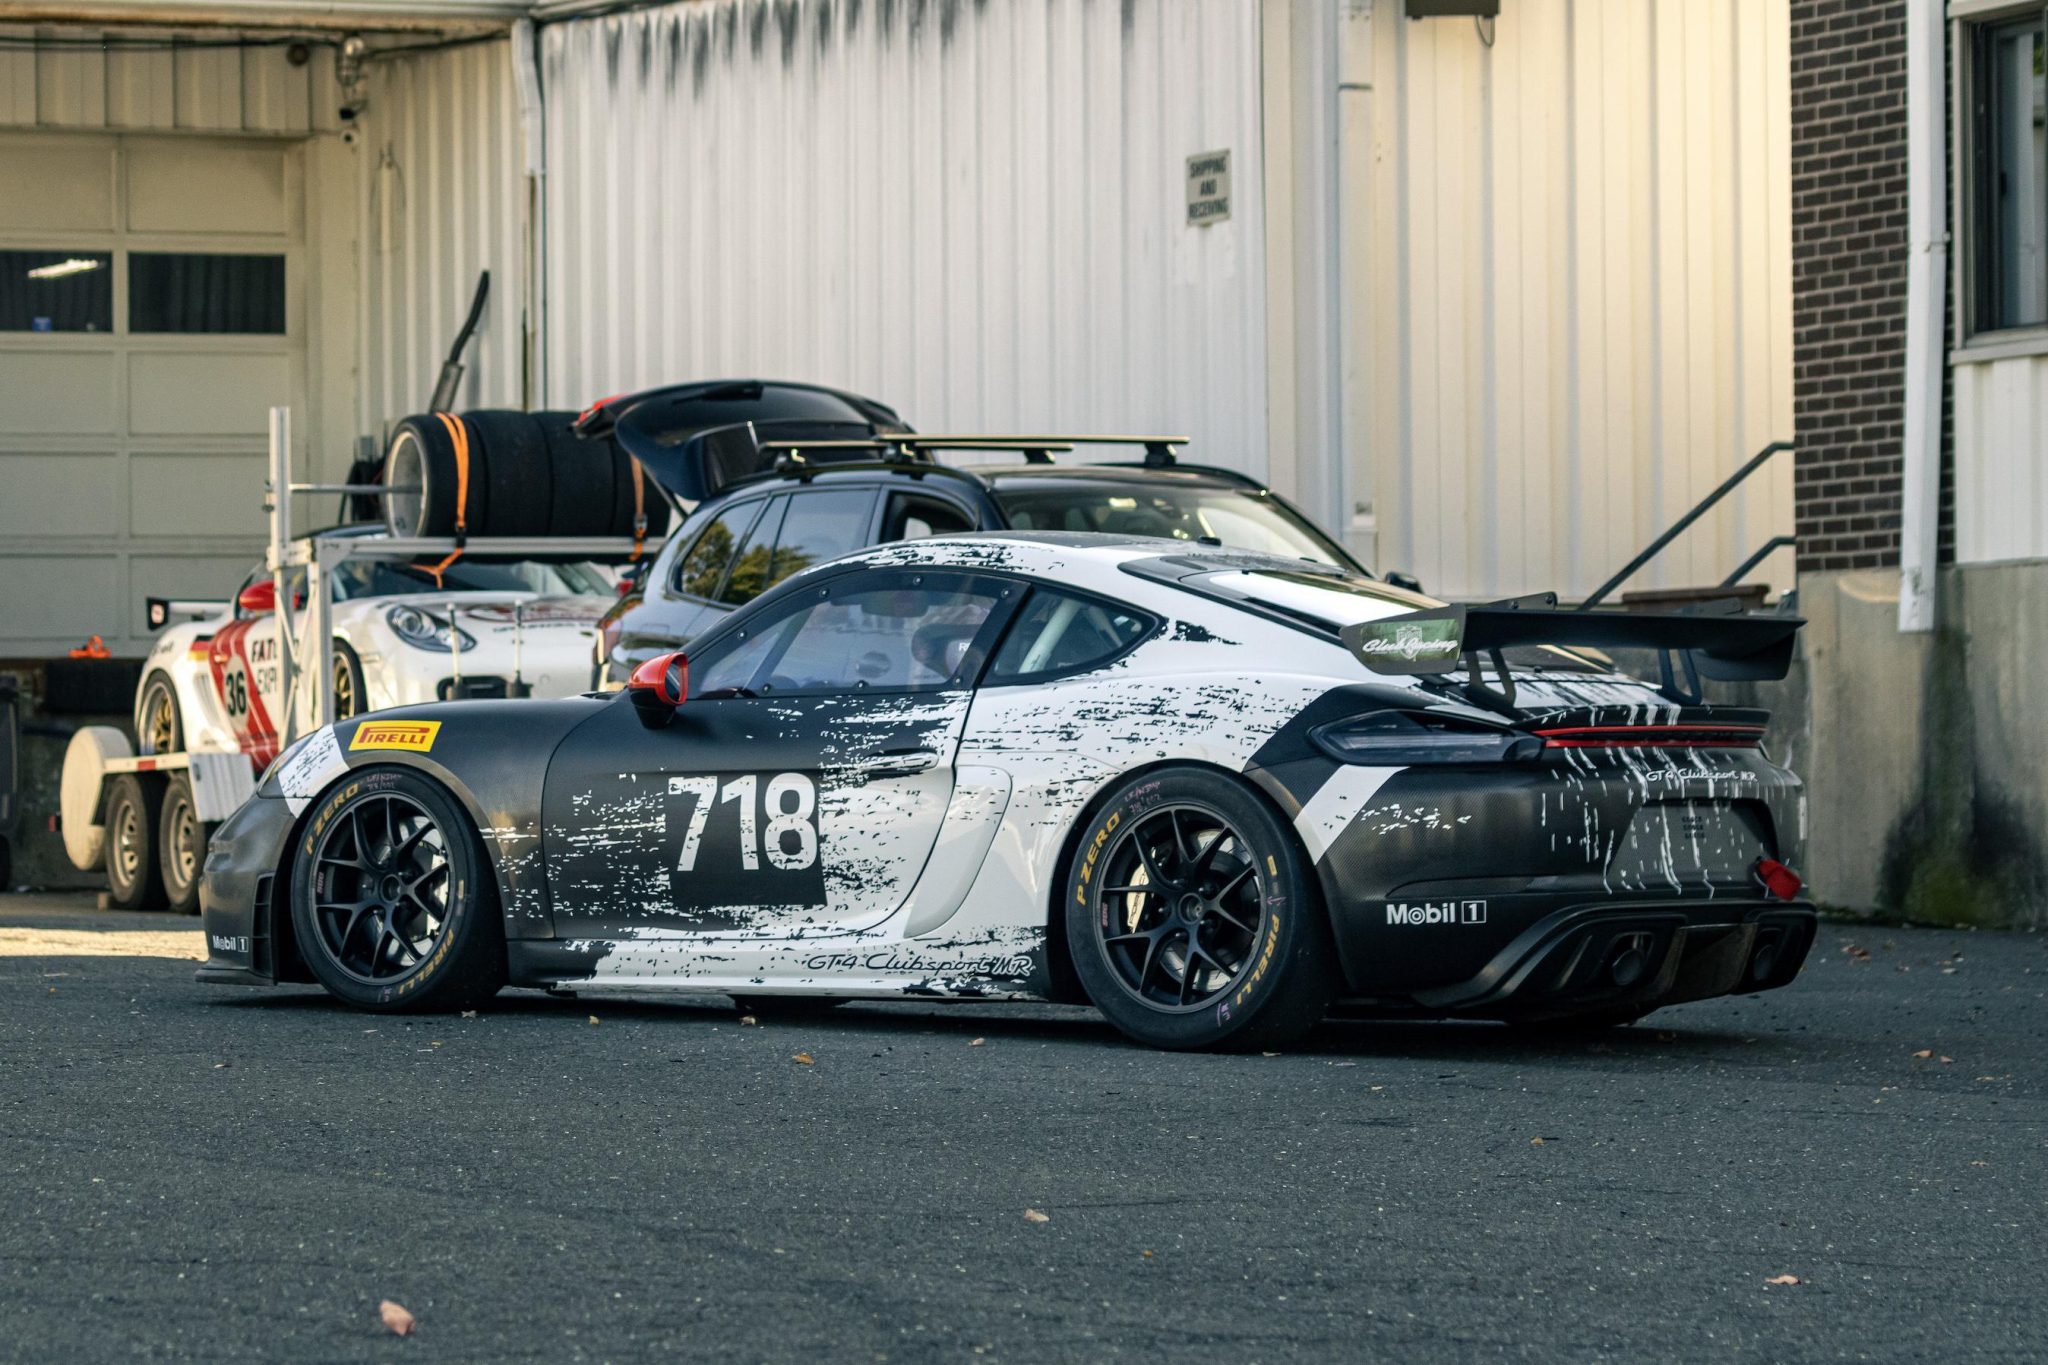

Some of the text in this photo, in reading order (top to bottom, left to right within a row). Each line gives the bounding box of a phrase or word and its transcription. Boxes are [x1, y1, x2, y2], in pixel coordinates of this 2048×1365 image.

[225, 670, 247, 717] 36
[358, 726, 430, 744] PIRELLI
[314, 783, 360, 837] ZERO
[668, 772, 818, 872] 718
[1081, 812, 1120, 884] ZERO
[1386, 902, 1456, 925] Mobil
[212, 935, 237, 950] Mobil
[399, 928, 455, 995] PIRELLI
[807, 953, 1033, 977] GT4 Clubsport MR
[1236, 914, 1281, 1006] PIRELLI
